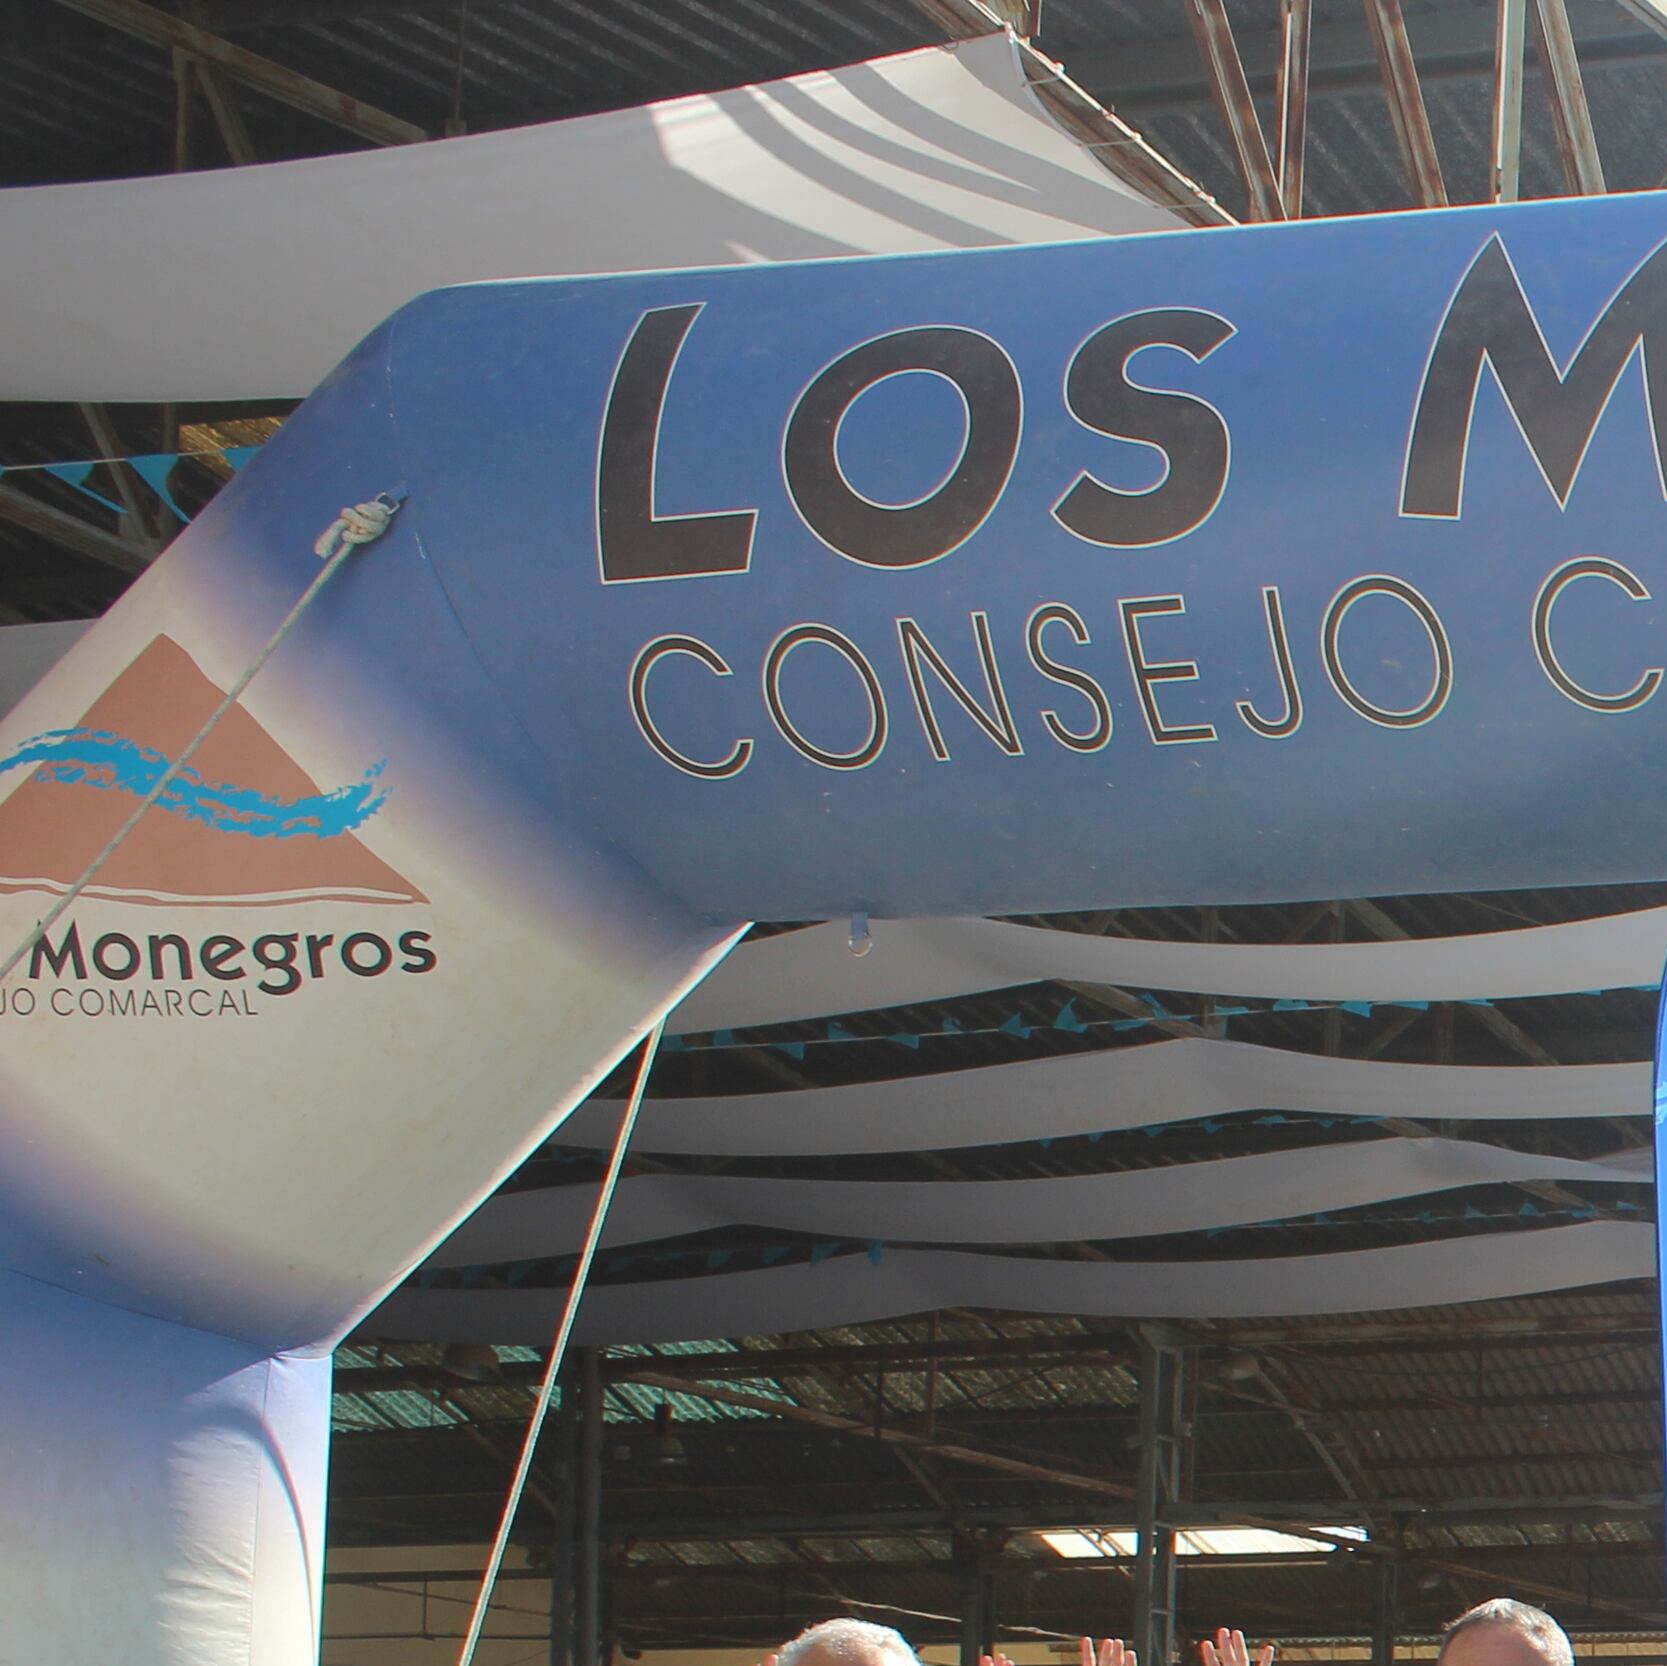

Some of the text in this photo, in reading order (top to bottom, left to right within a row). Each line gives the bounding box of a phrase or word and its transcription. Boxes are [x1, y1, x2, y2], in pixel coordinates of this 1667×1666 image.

[596, 302, 1238, 586] Los
[629, 574, 1453, 780] CONSEJO
[29, 919, 437, 996] Monegros
[51, 988, 259, 1017] COMARCAL
